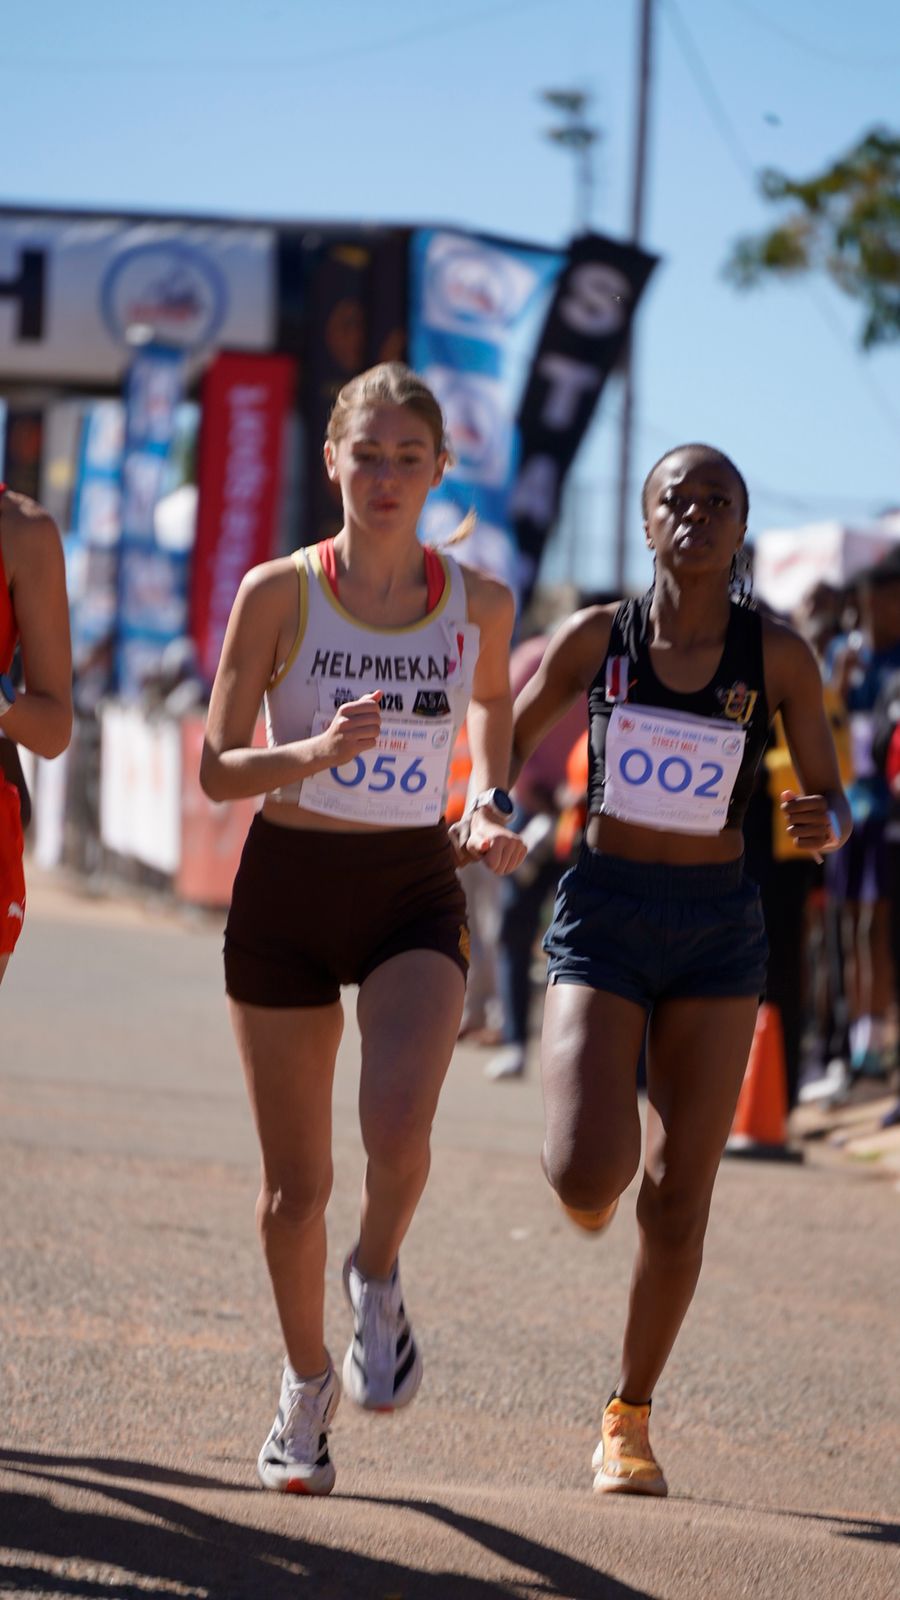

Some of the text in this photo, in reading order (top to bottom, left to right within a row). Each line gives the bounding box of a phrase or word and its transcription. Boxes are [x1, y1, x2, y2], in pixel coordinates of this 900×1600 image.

[379, 691, 404, 712] 026
[330, 755, 427, 794] 056
[619, 747, 724, 798] 002
